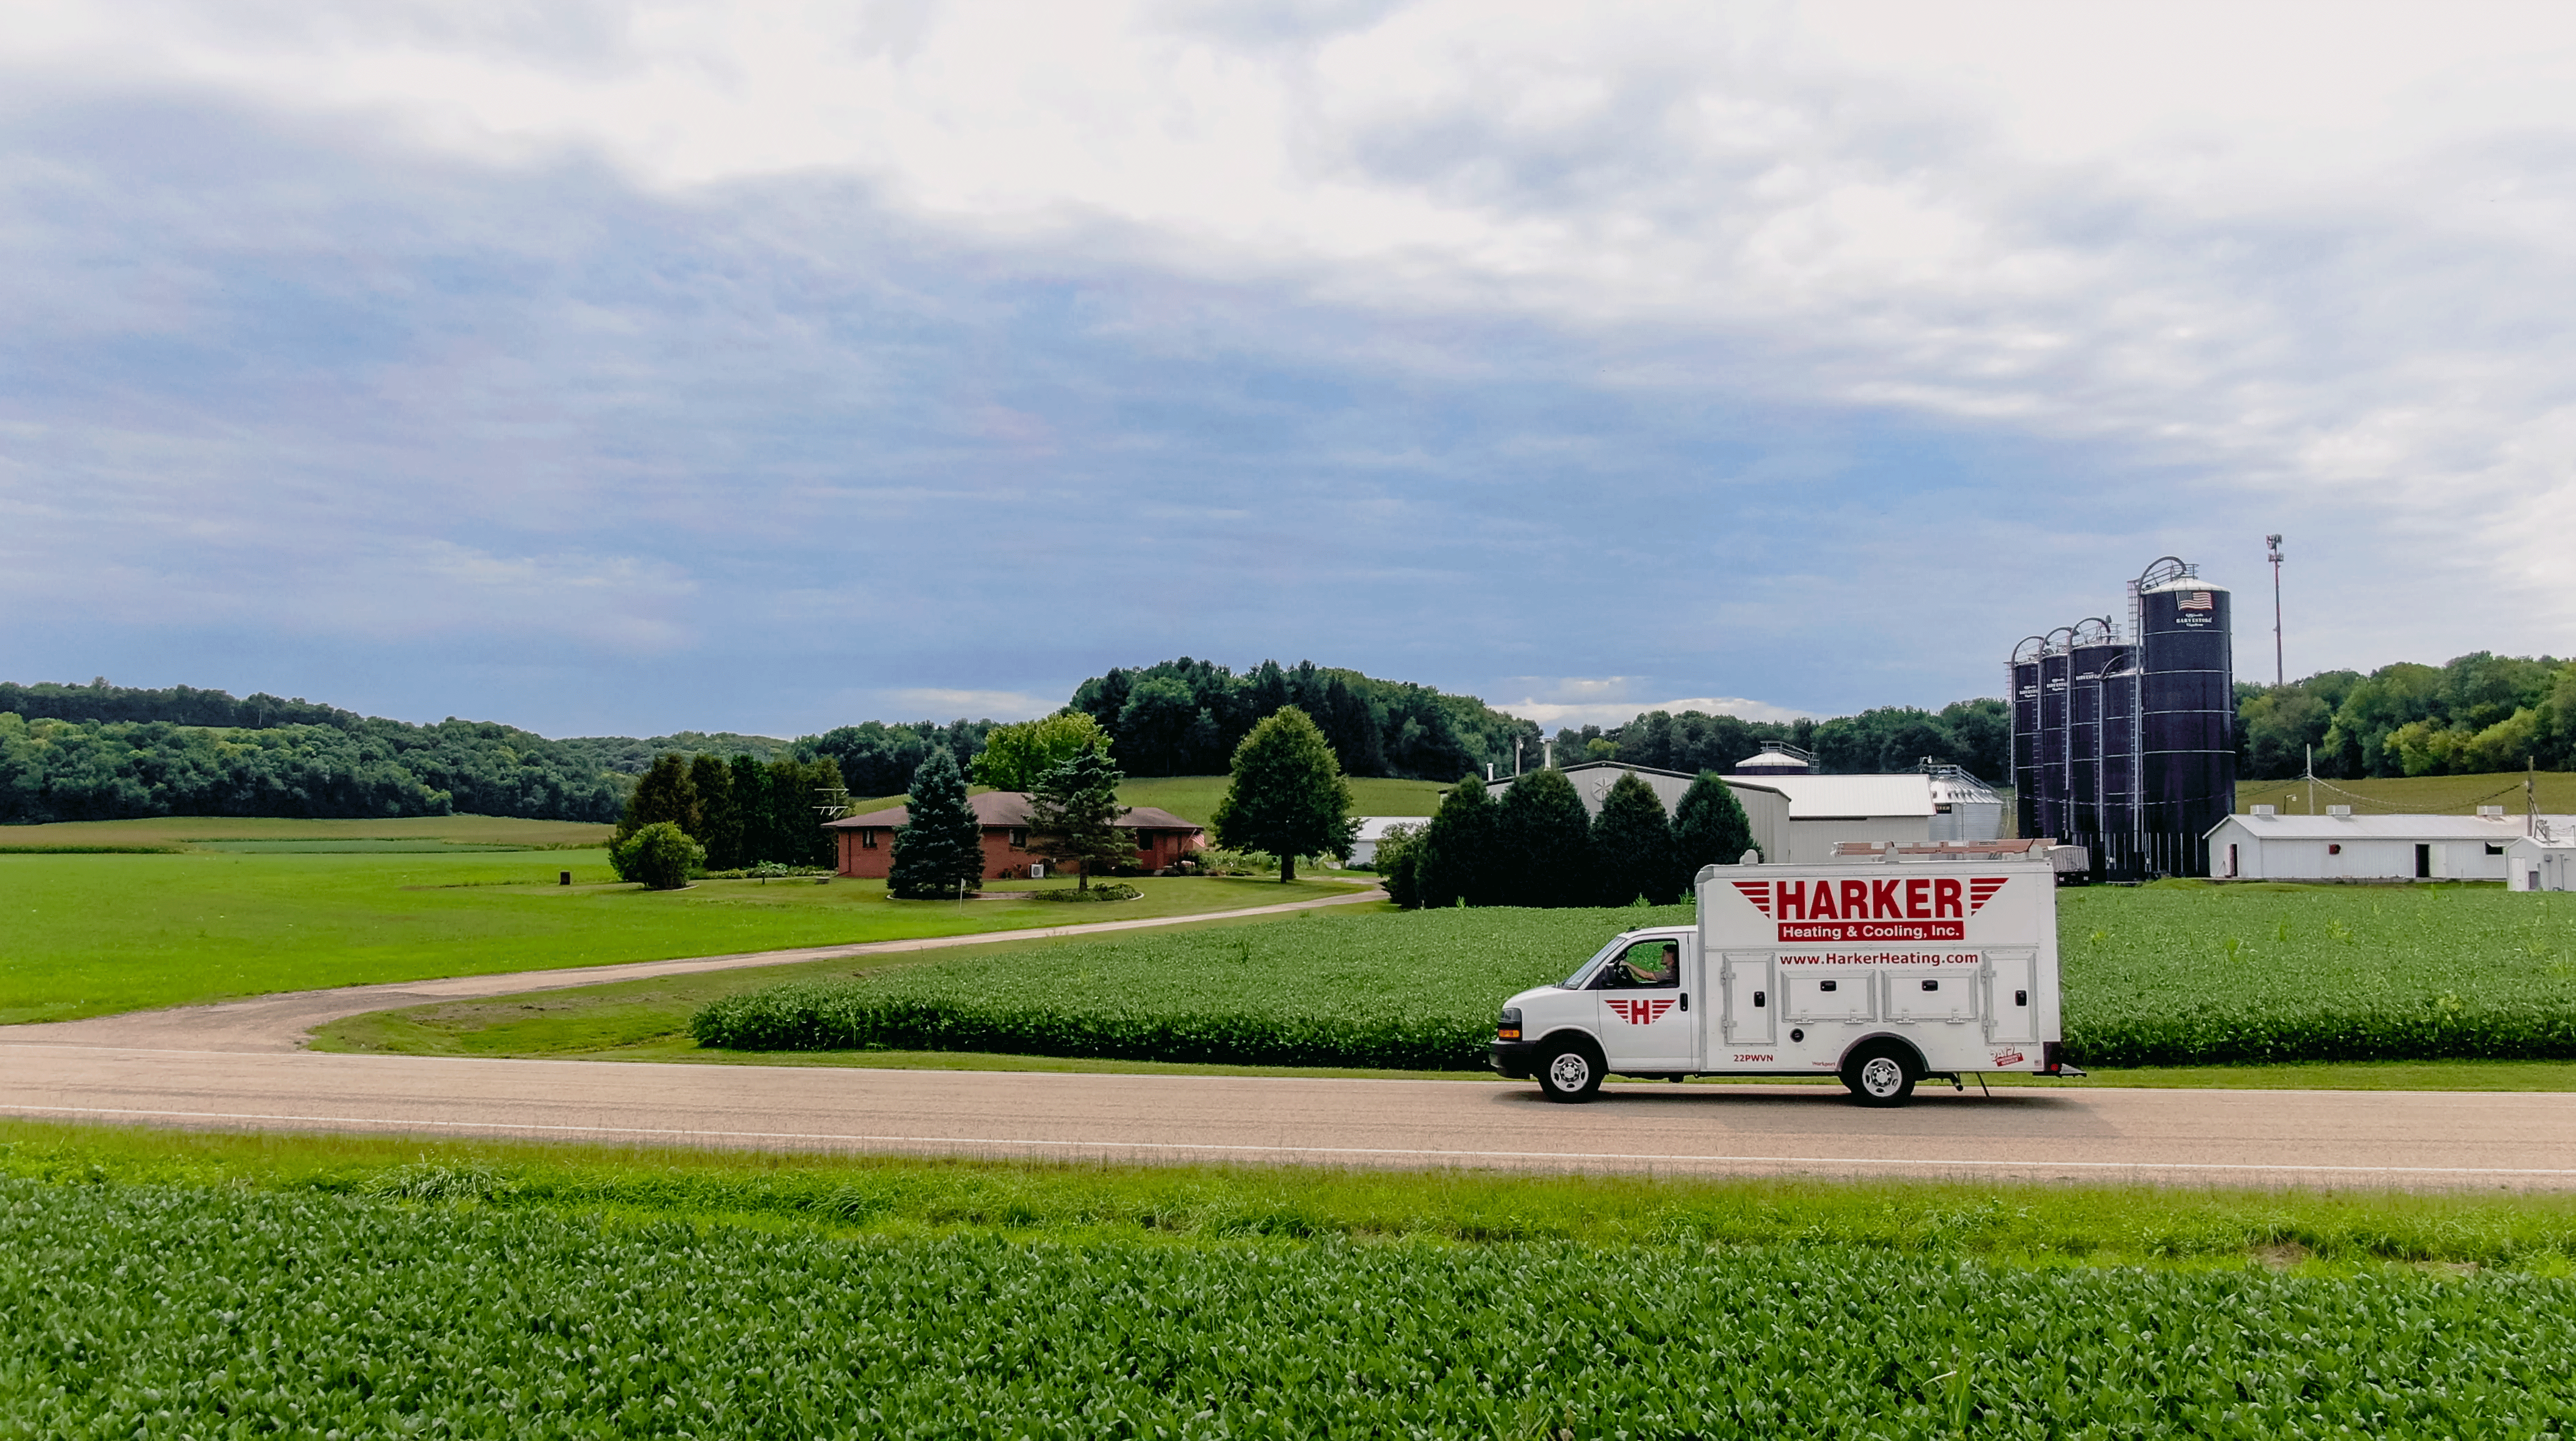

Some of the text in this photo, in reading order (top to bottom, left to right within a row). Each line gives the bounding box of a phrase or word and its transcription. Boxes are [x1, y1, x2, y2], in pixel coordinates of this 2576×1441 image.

[1776, 878, 1964, 920] HARKER
[1783, 924, 1960, 940] Heating & Cooling, Inc.
[1780, 952, 1979, 966] www.HarkerHeating.com
[1631, 999, 1650, 1024] H
[1733, 1054, 1773, 1062] 22PWVN
